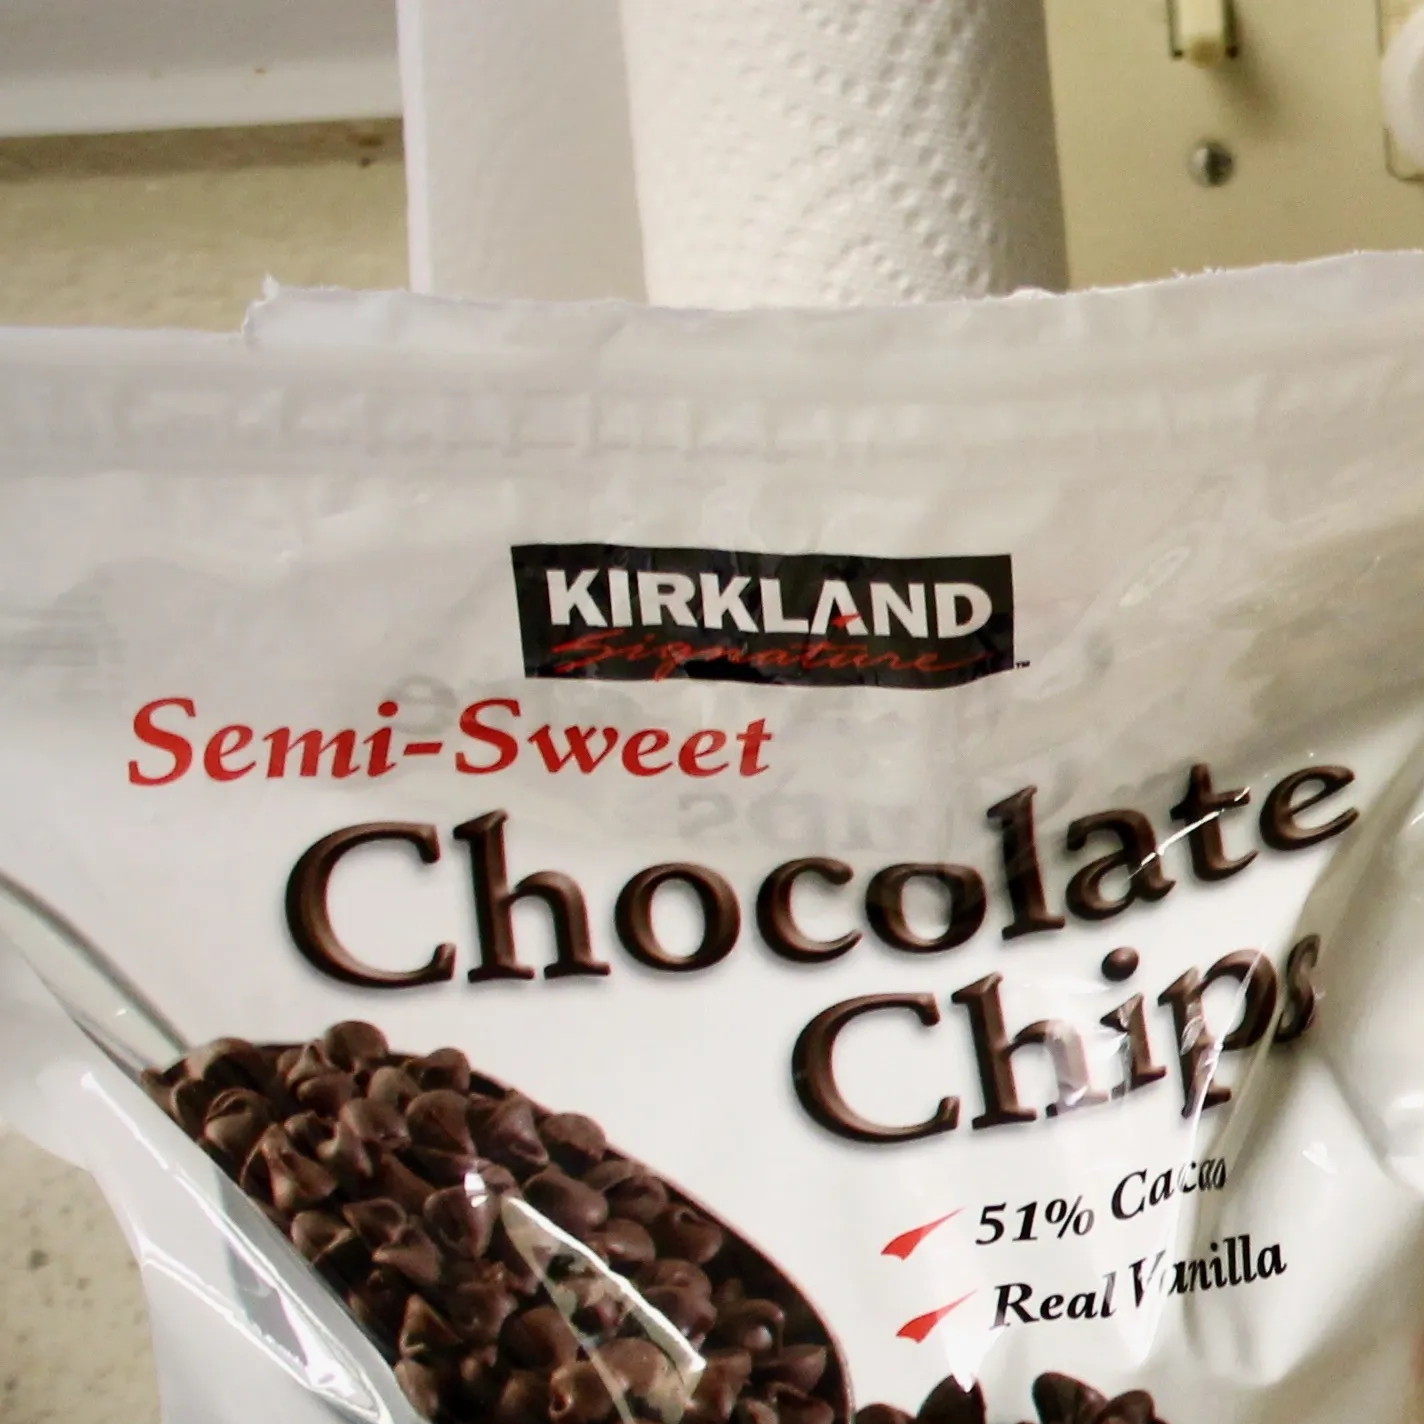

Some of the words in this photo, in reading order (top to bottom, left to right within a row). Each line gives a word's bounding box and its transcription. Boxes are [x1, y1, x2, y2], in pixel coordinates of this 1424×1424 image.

[545, 566, 993, 639] KIRKLAND
[549, 629, 979, 682] Signature
[127, 697, 772, 787] Semi-Sweet
[284, 763, 1360, 990] Chocolate
[791, 934, 1322, 1144] Chips
[975, 1195, 1094, 1247] 51%
[1111, 1156, 1227, 1222] Cacao
[989, 1271, 1116, 1330] Real
[1129, 1234, 1287, 1311] Vanilla
